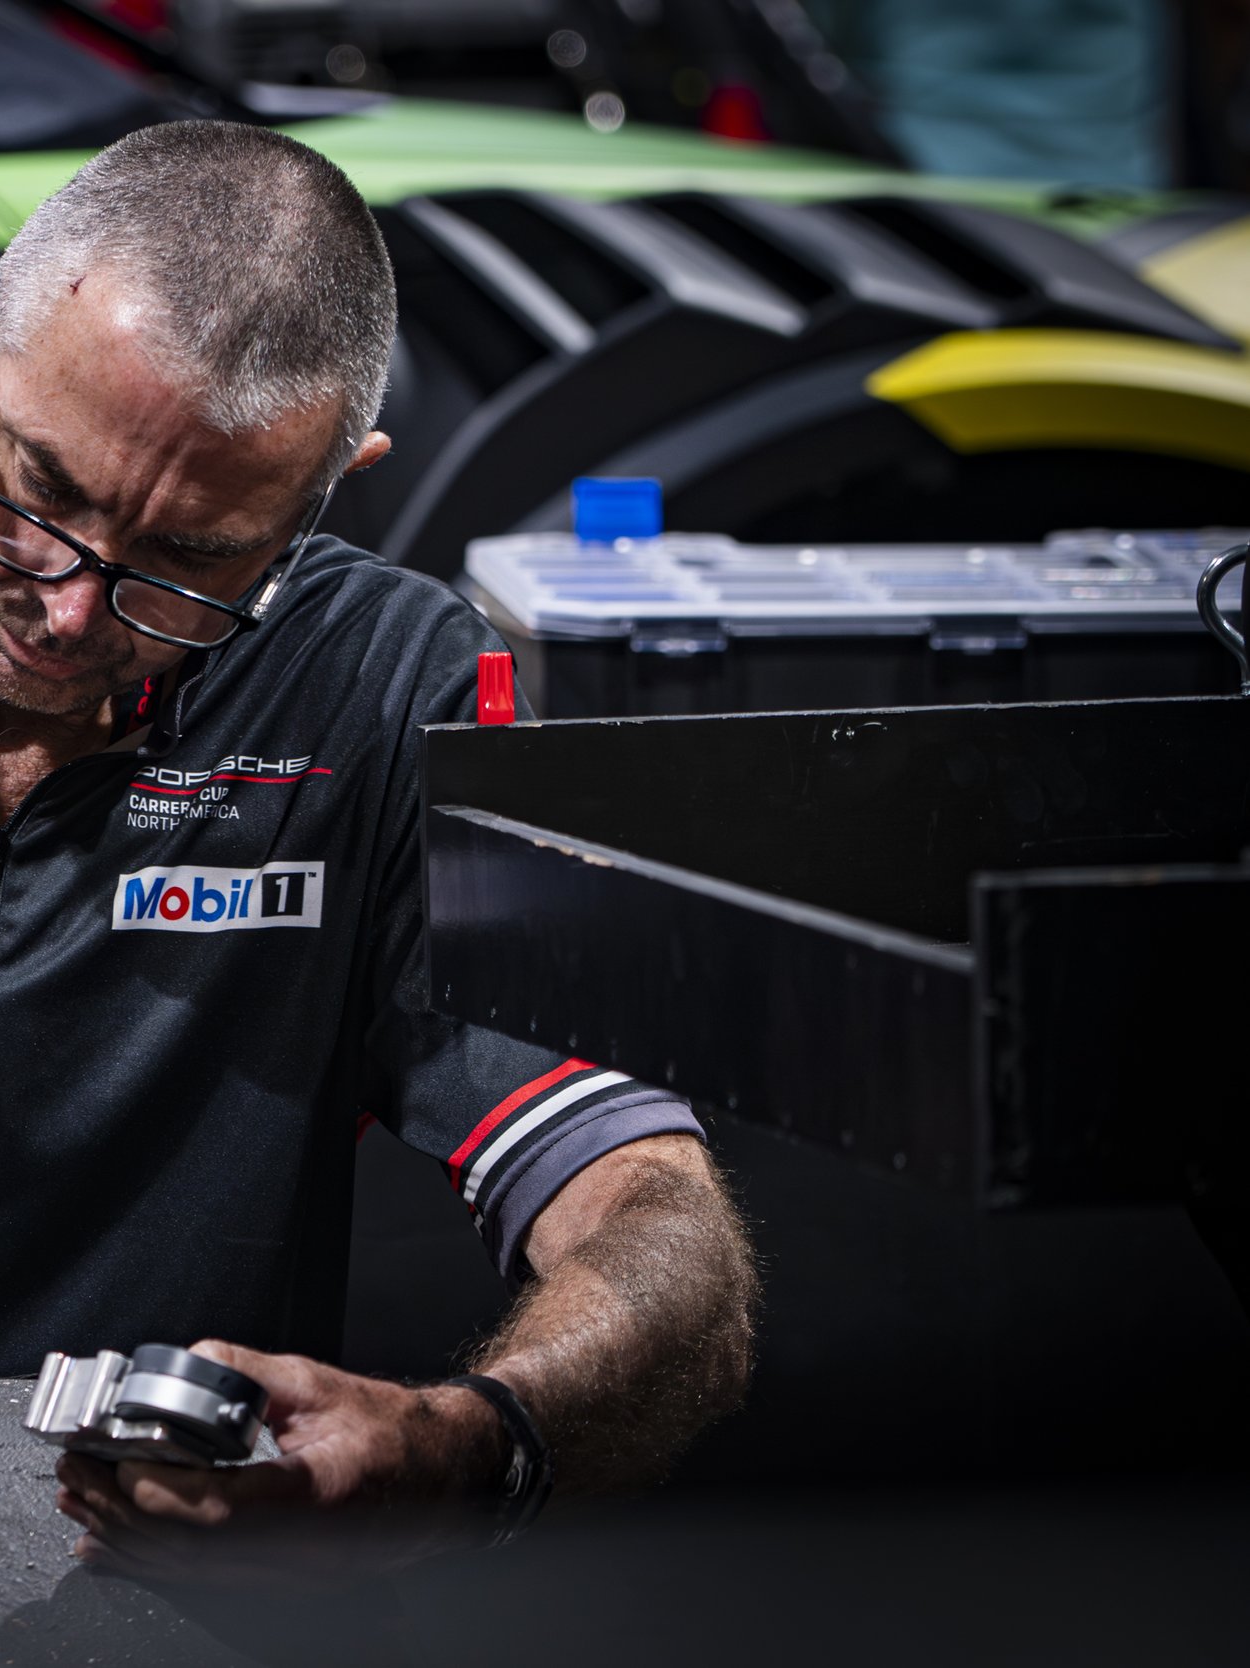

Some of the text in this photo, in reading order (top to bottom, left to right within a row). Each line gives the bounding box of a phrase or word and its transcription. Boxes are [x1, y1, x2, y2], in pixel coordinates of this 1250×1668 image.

[129, 786, 230, 815] CARRER CUP
[185, 803, 240, 820] MEICA
[123, 877, 254, 922] Mobil
